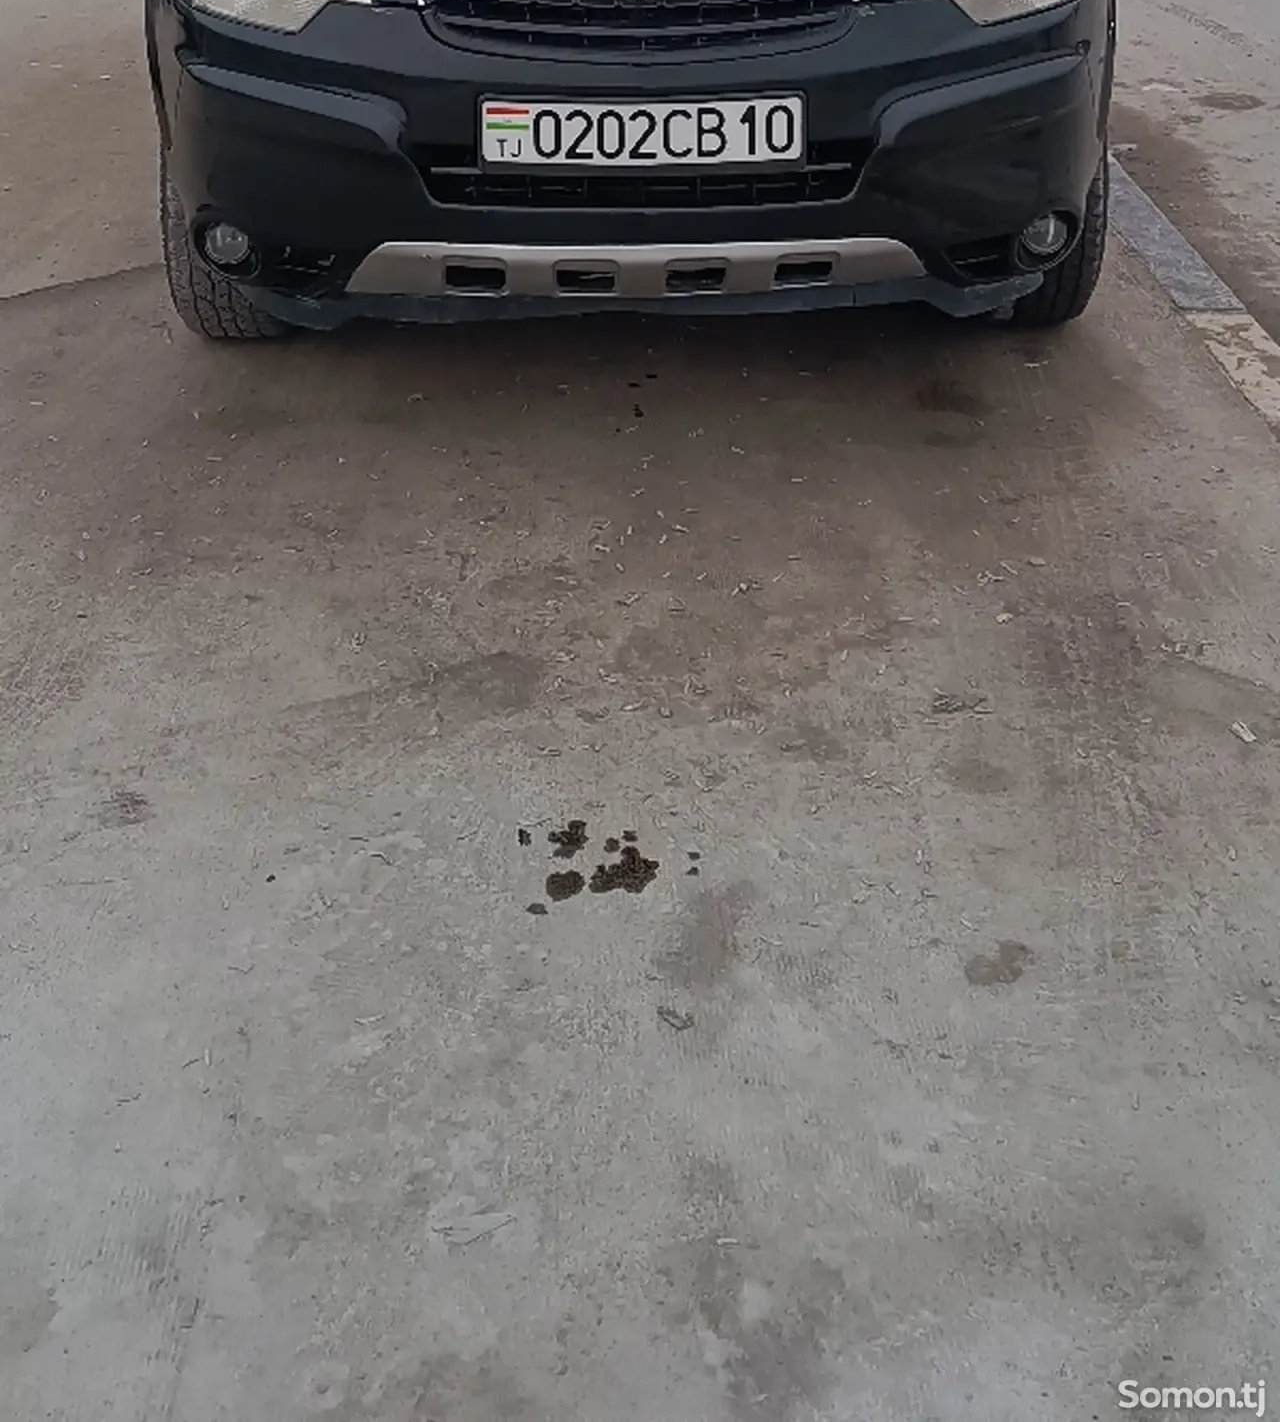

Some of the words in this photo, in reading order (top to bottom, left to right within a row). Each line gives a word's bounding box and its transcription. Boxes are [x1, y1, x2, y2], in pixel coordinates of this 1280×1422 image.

[496, 138, 522, 158] TJ
[533, 107, 728, 160] 0202CB
[739, 104, 795, 156] 10
